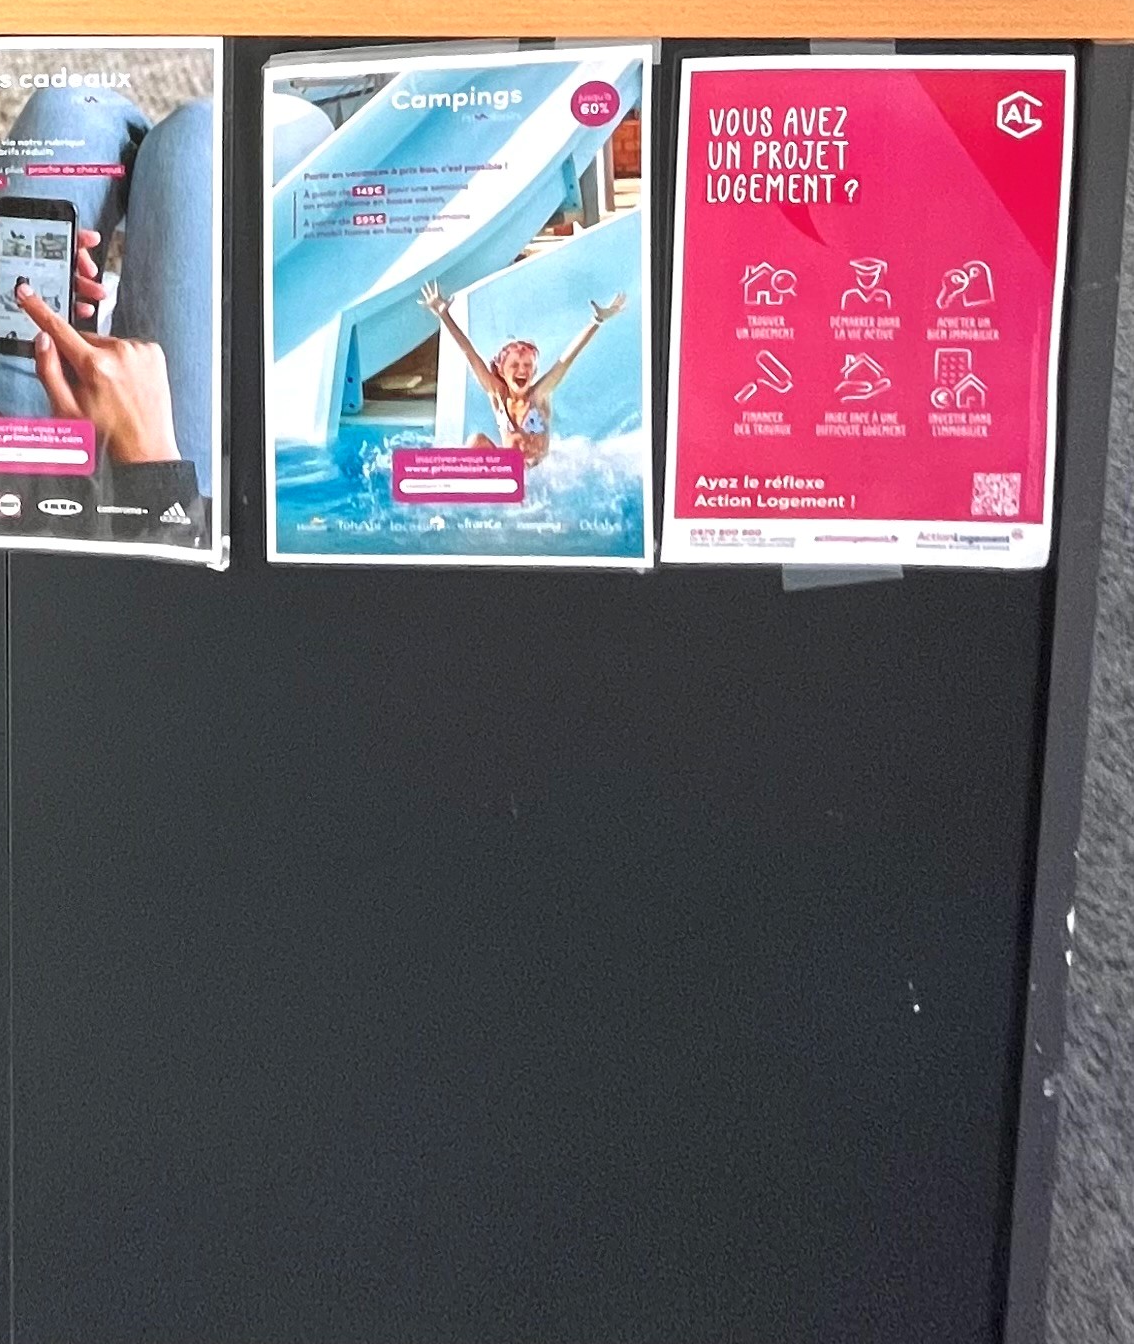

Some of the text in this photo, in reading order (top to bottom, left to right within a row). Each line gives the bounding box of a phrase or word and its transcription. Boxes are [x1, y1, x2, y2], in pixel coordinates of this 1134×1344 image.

[19, 66, 132, 89] cadeaux
[391, 85, 523, 113] Campings
[579, 102, 610, 115] 60%
[708, 106, 849, 137] VOUS AVEZ
[707, 140, 850, 170] UN PROJET
[706, 173, 860, 204] LOGEMENT ?
[694, 475, 825, 491] Ayez le réflexe
[694, 494, 752, 509] Action
[756, 494, 846, 510] Logement
